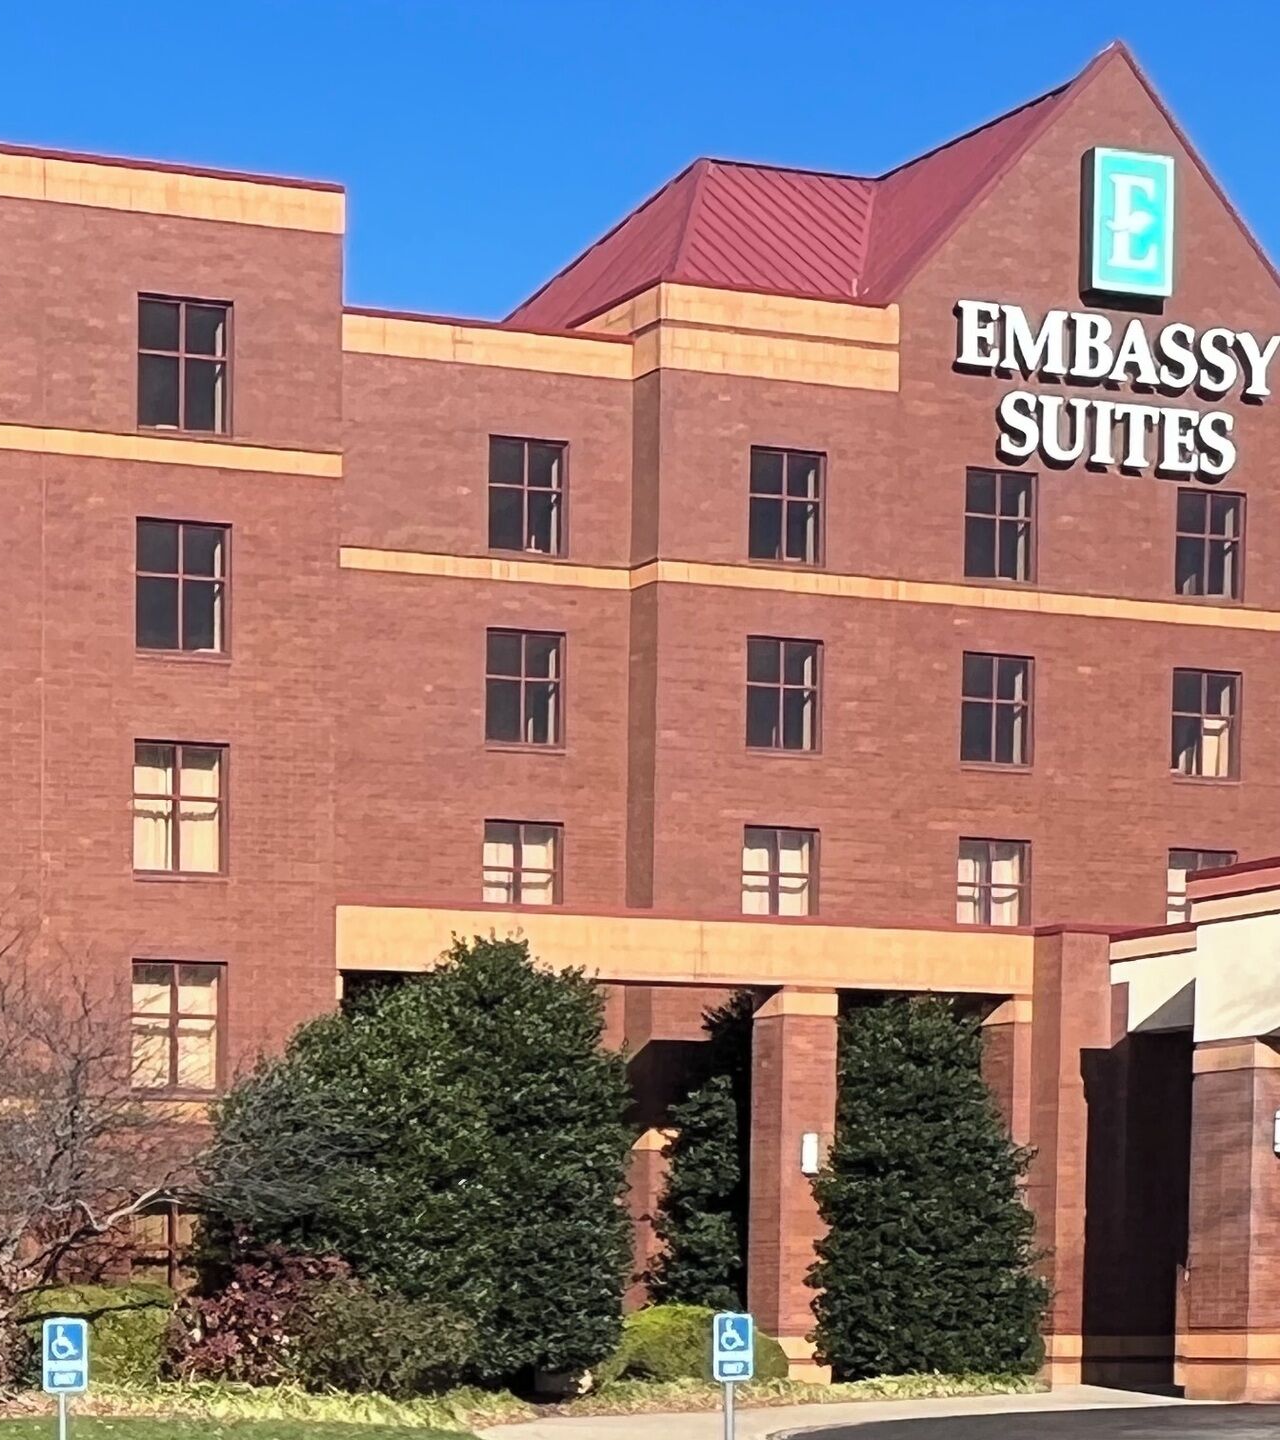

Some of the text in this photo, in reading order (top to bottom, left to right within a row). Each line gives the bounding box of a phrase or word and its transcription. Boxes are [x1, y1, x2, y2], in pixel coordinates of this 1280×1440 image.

[1106, 174, 1158, 269] E
[957, 300, 1280, 396] EMBASSY
[1000, 391, 1236, 475] SUITES
